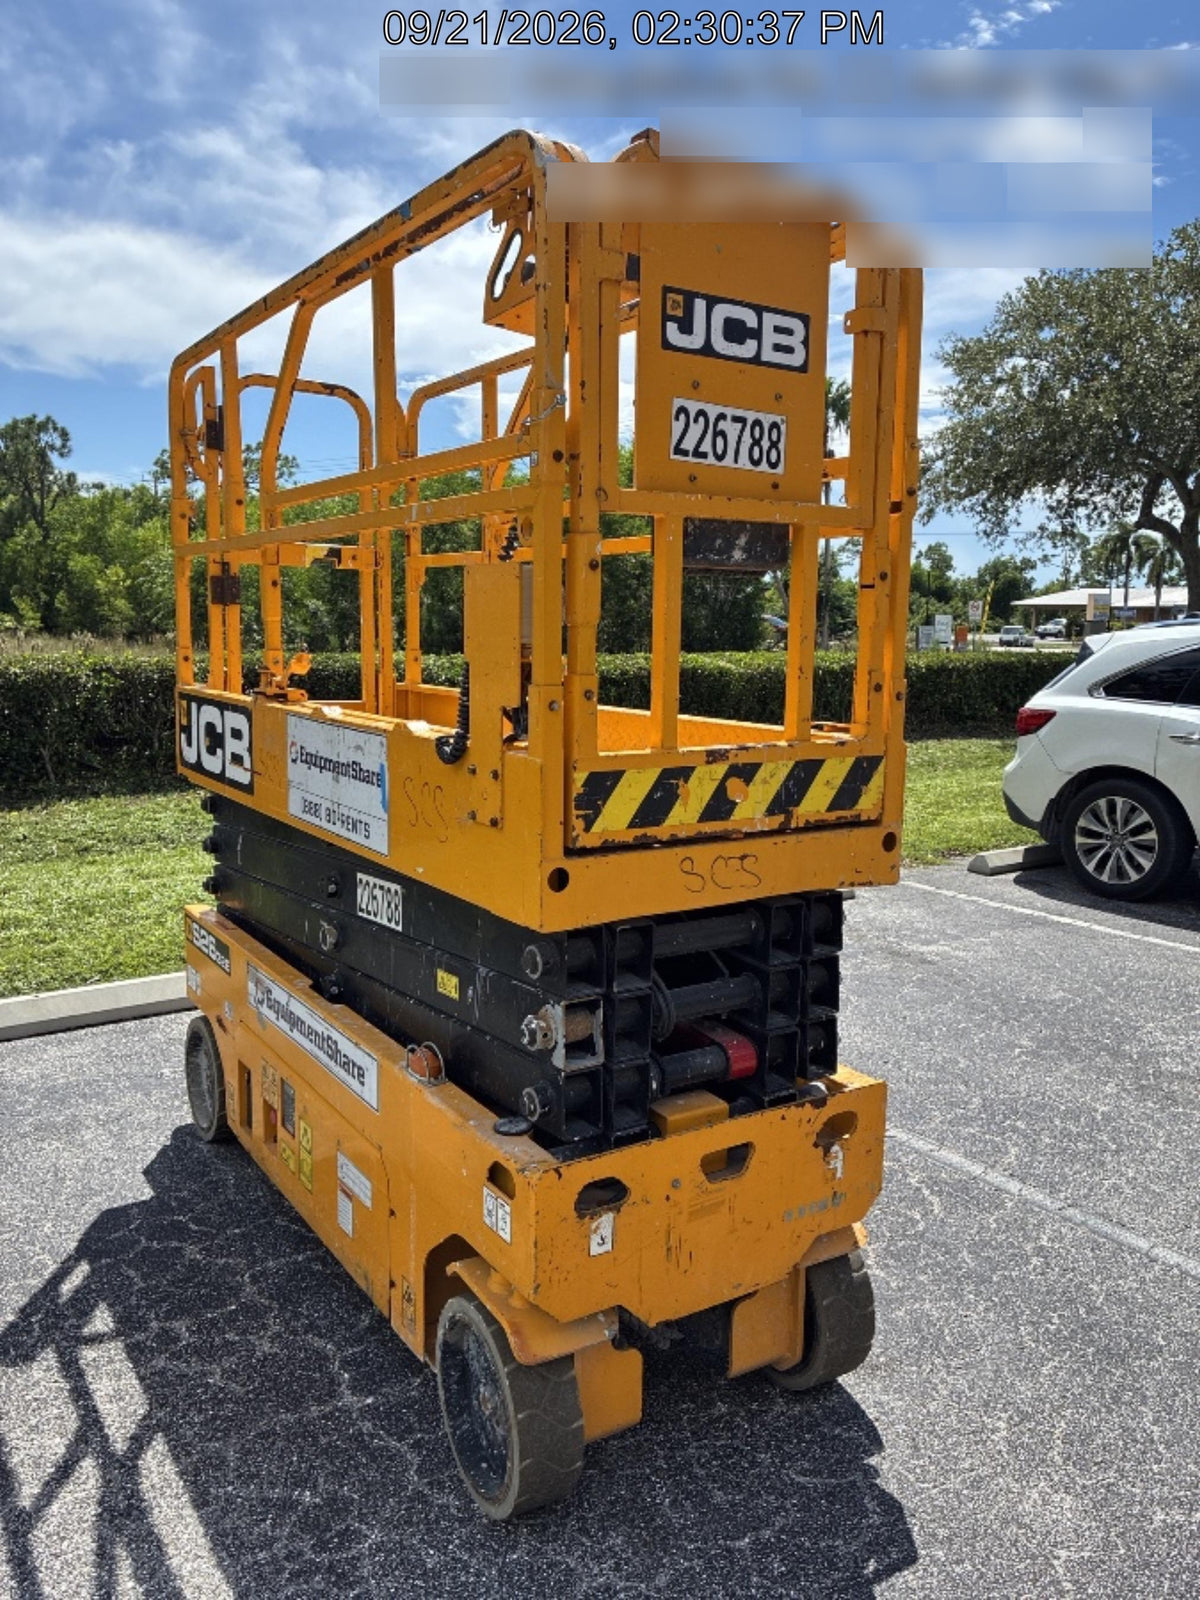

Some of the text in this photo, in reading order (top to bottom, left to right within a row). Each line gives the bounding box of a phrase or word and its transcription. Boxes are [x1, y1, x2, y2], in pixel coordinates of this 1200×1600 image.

[666, 298, 806, 367] JCB
[673, 405, 782, 470] 226788
[180, 701, 252, 784] JCB
[300, 745, 382, 789] EquipmentShare
[678, 853, 762, 893] SCS
[266, 989, 366, 1087] EquipmentShare
